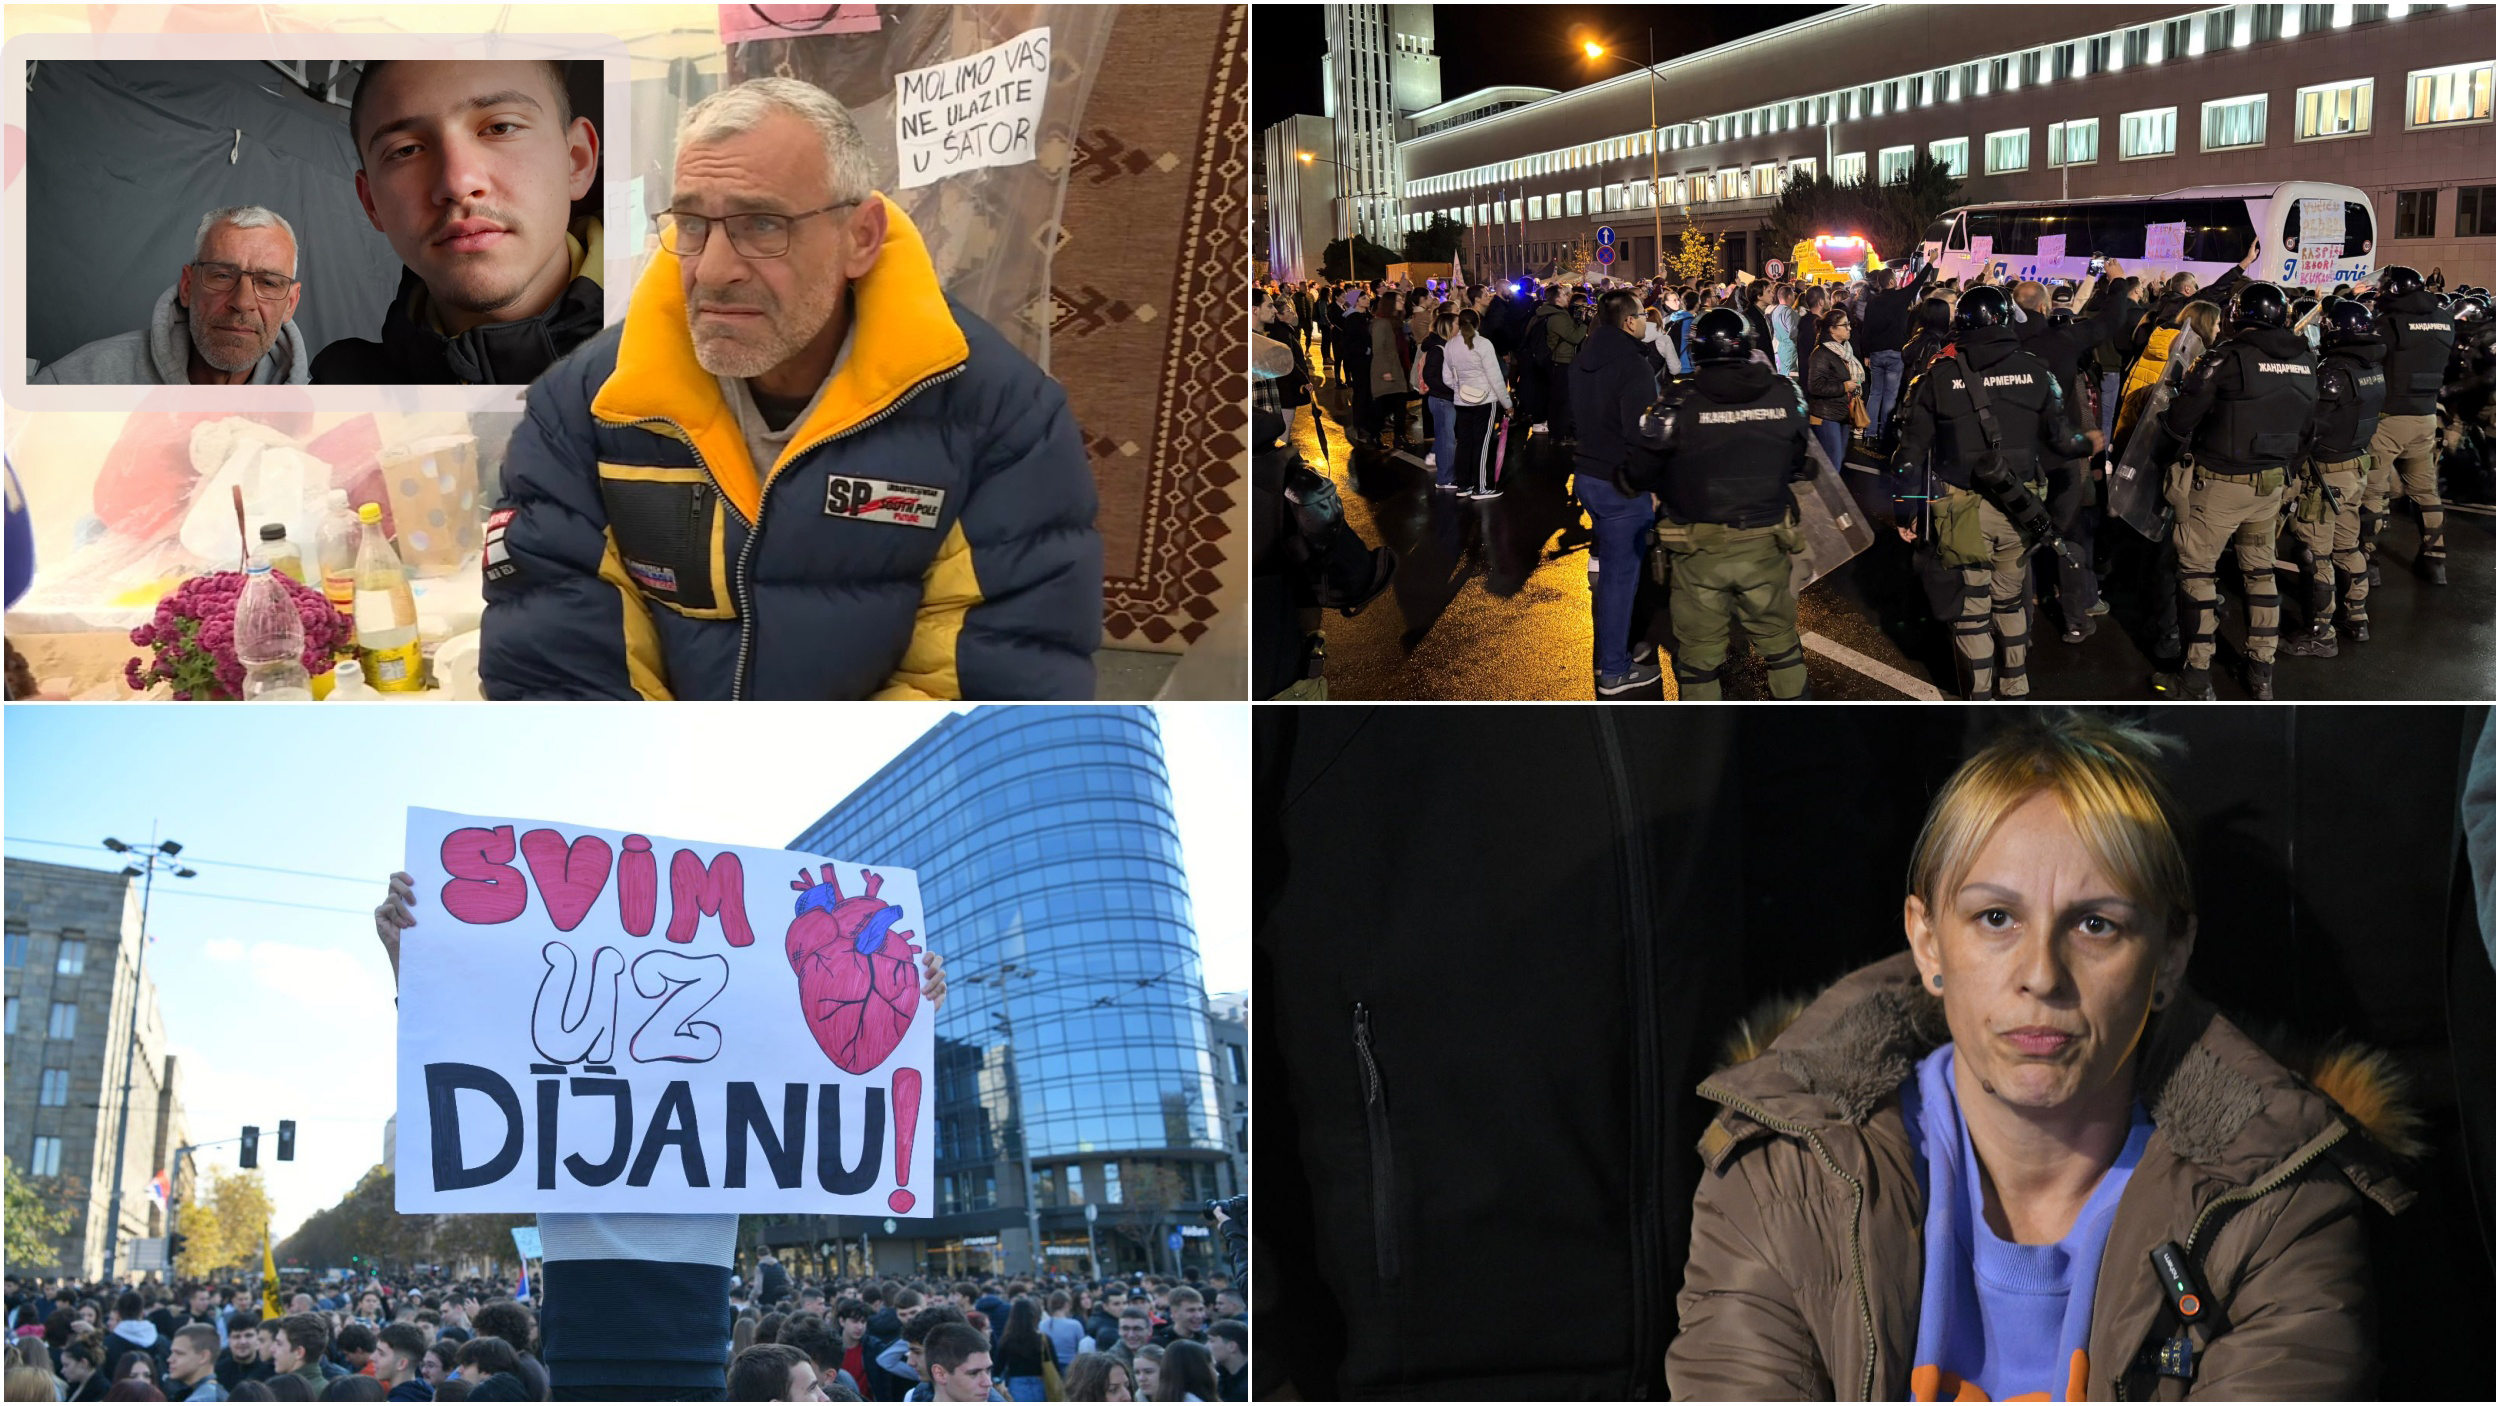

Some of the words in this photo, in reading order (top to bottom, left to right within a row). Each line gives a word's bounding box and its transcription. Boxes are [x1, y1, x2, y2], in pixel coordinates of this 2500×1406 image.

[903, 55, 996, 106] MOLIMO
[1005, 37, 1049, 73] VAS
[902, 110, 938, 140] NE
[947, 79, 1032, 126] ULAZITE
[913, 150, 931, 173] U
[943, 117, 1031, 165] ŠATOR
[1770, 263, 1780, 275] 10
[2258, 362, 2312, 375] ЖАНДАРМЕРИЈА
[827, 478, 873, 516] SP
[915, 503, 938, 516] POLE
[441, 825, 755, 947] SVIM
[531, 941, 729, 1065] UZ
